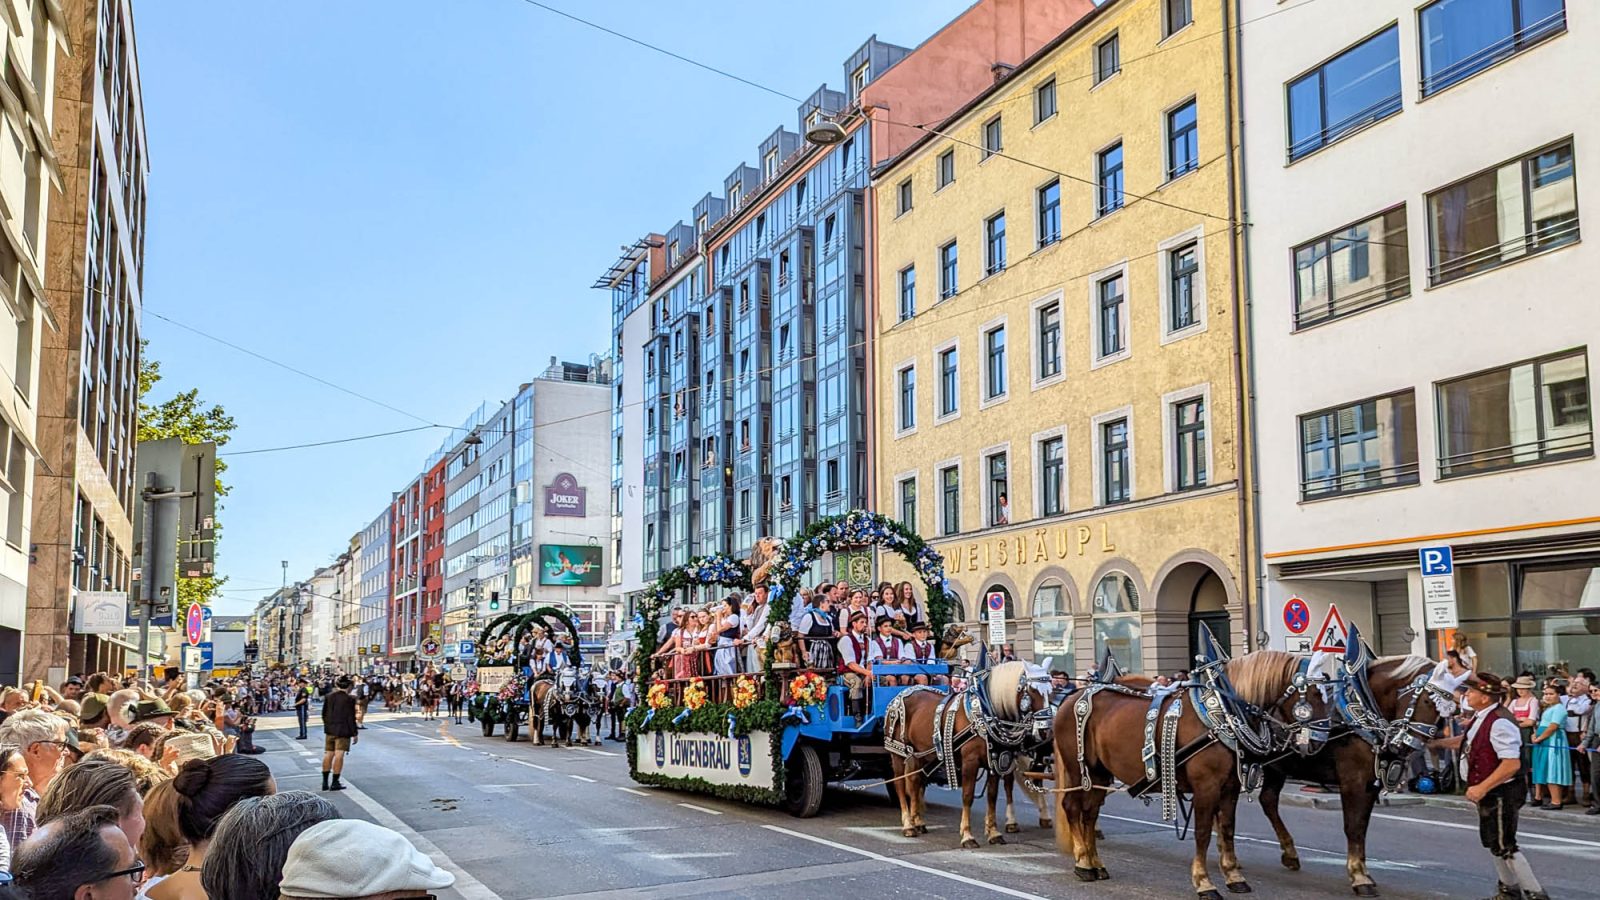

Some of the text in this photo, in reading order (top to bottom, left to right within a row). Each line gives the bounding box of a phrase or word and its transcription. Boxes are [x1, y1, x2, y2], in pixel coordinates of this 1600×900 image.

[550, 493, 579, 504] JOKER
[949, 522, 1116, 574] WEISHÄUPL
[1424, 550, 1443, 573] P
[462, 642, 472, 653] P
[670, 734, 731, 770] LÖWENBRÄU
